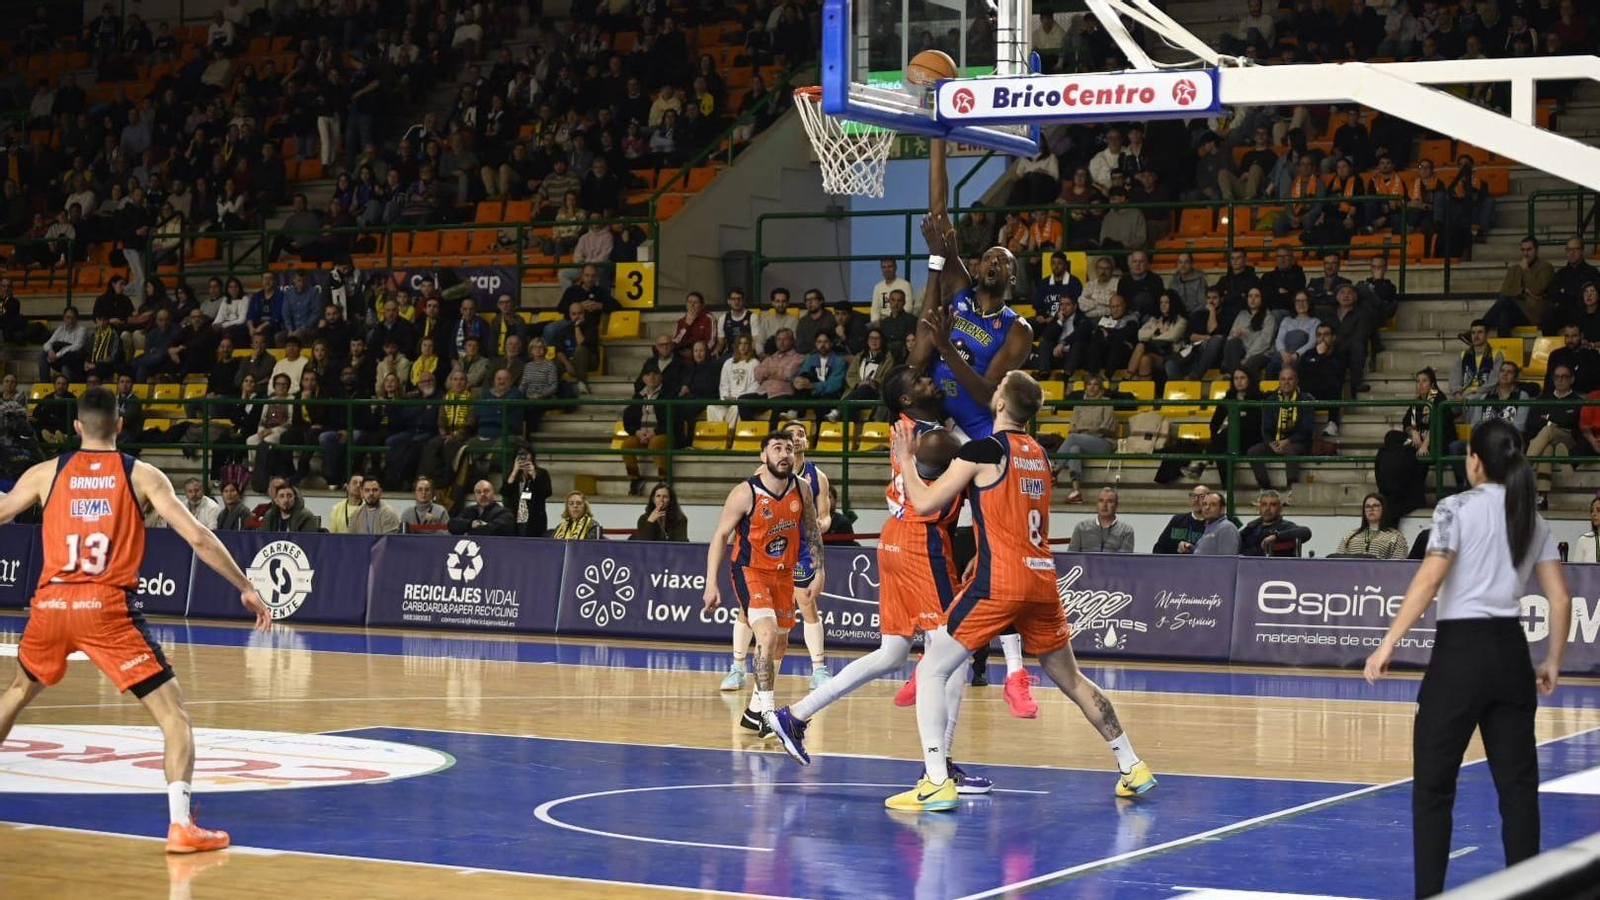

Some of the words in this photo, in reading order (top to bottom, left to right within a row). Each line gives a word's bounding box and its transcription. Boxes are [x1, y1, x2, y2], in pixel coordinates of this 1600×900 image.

[992, 83, 1156, 109] BricoCentro
[626, 270, 643, 301] 3
[70, 475, 116, 490] BRNOVIC
[71, 499, 112, 517] LEYMA
[1028, 508, 1042, 549] 8
[62, 531, 112, 575] 13
[262, 543, 302, 559] CARNES
[404, 584, 482, 604] RECICLAJES
[484, 589, 519, 606] VIDAL
[474, 605, 519, 618] RECYCLING
[647, 600, 691, 622] low
[700, 605, 740, 625] cos
[842, 612, 864, 627] DO
[1256, 632, 1337, 646] materiales
[1340, 633, 1360, 646] de
